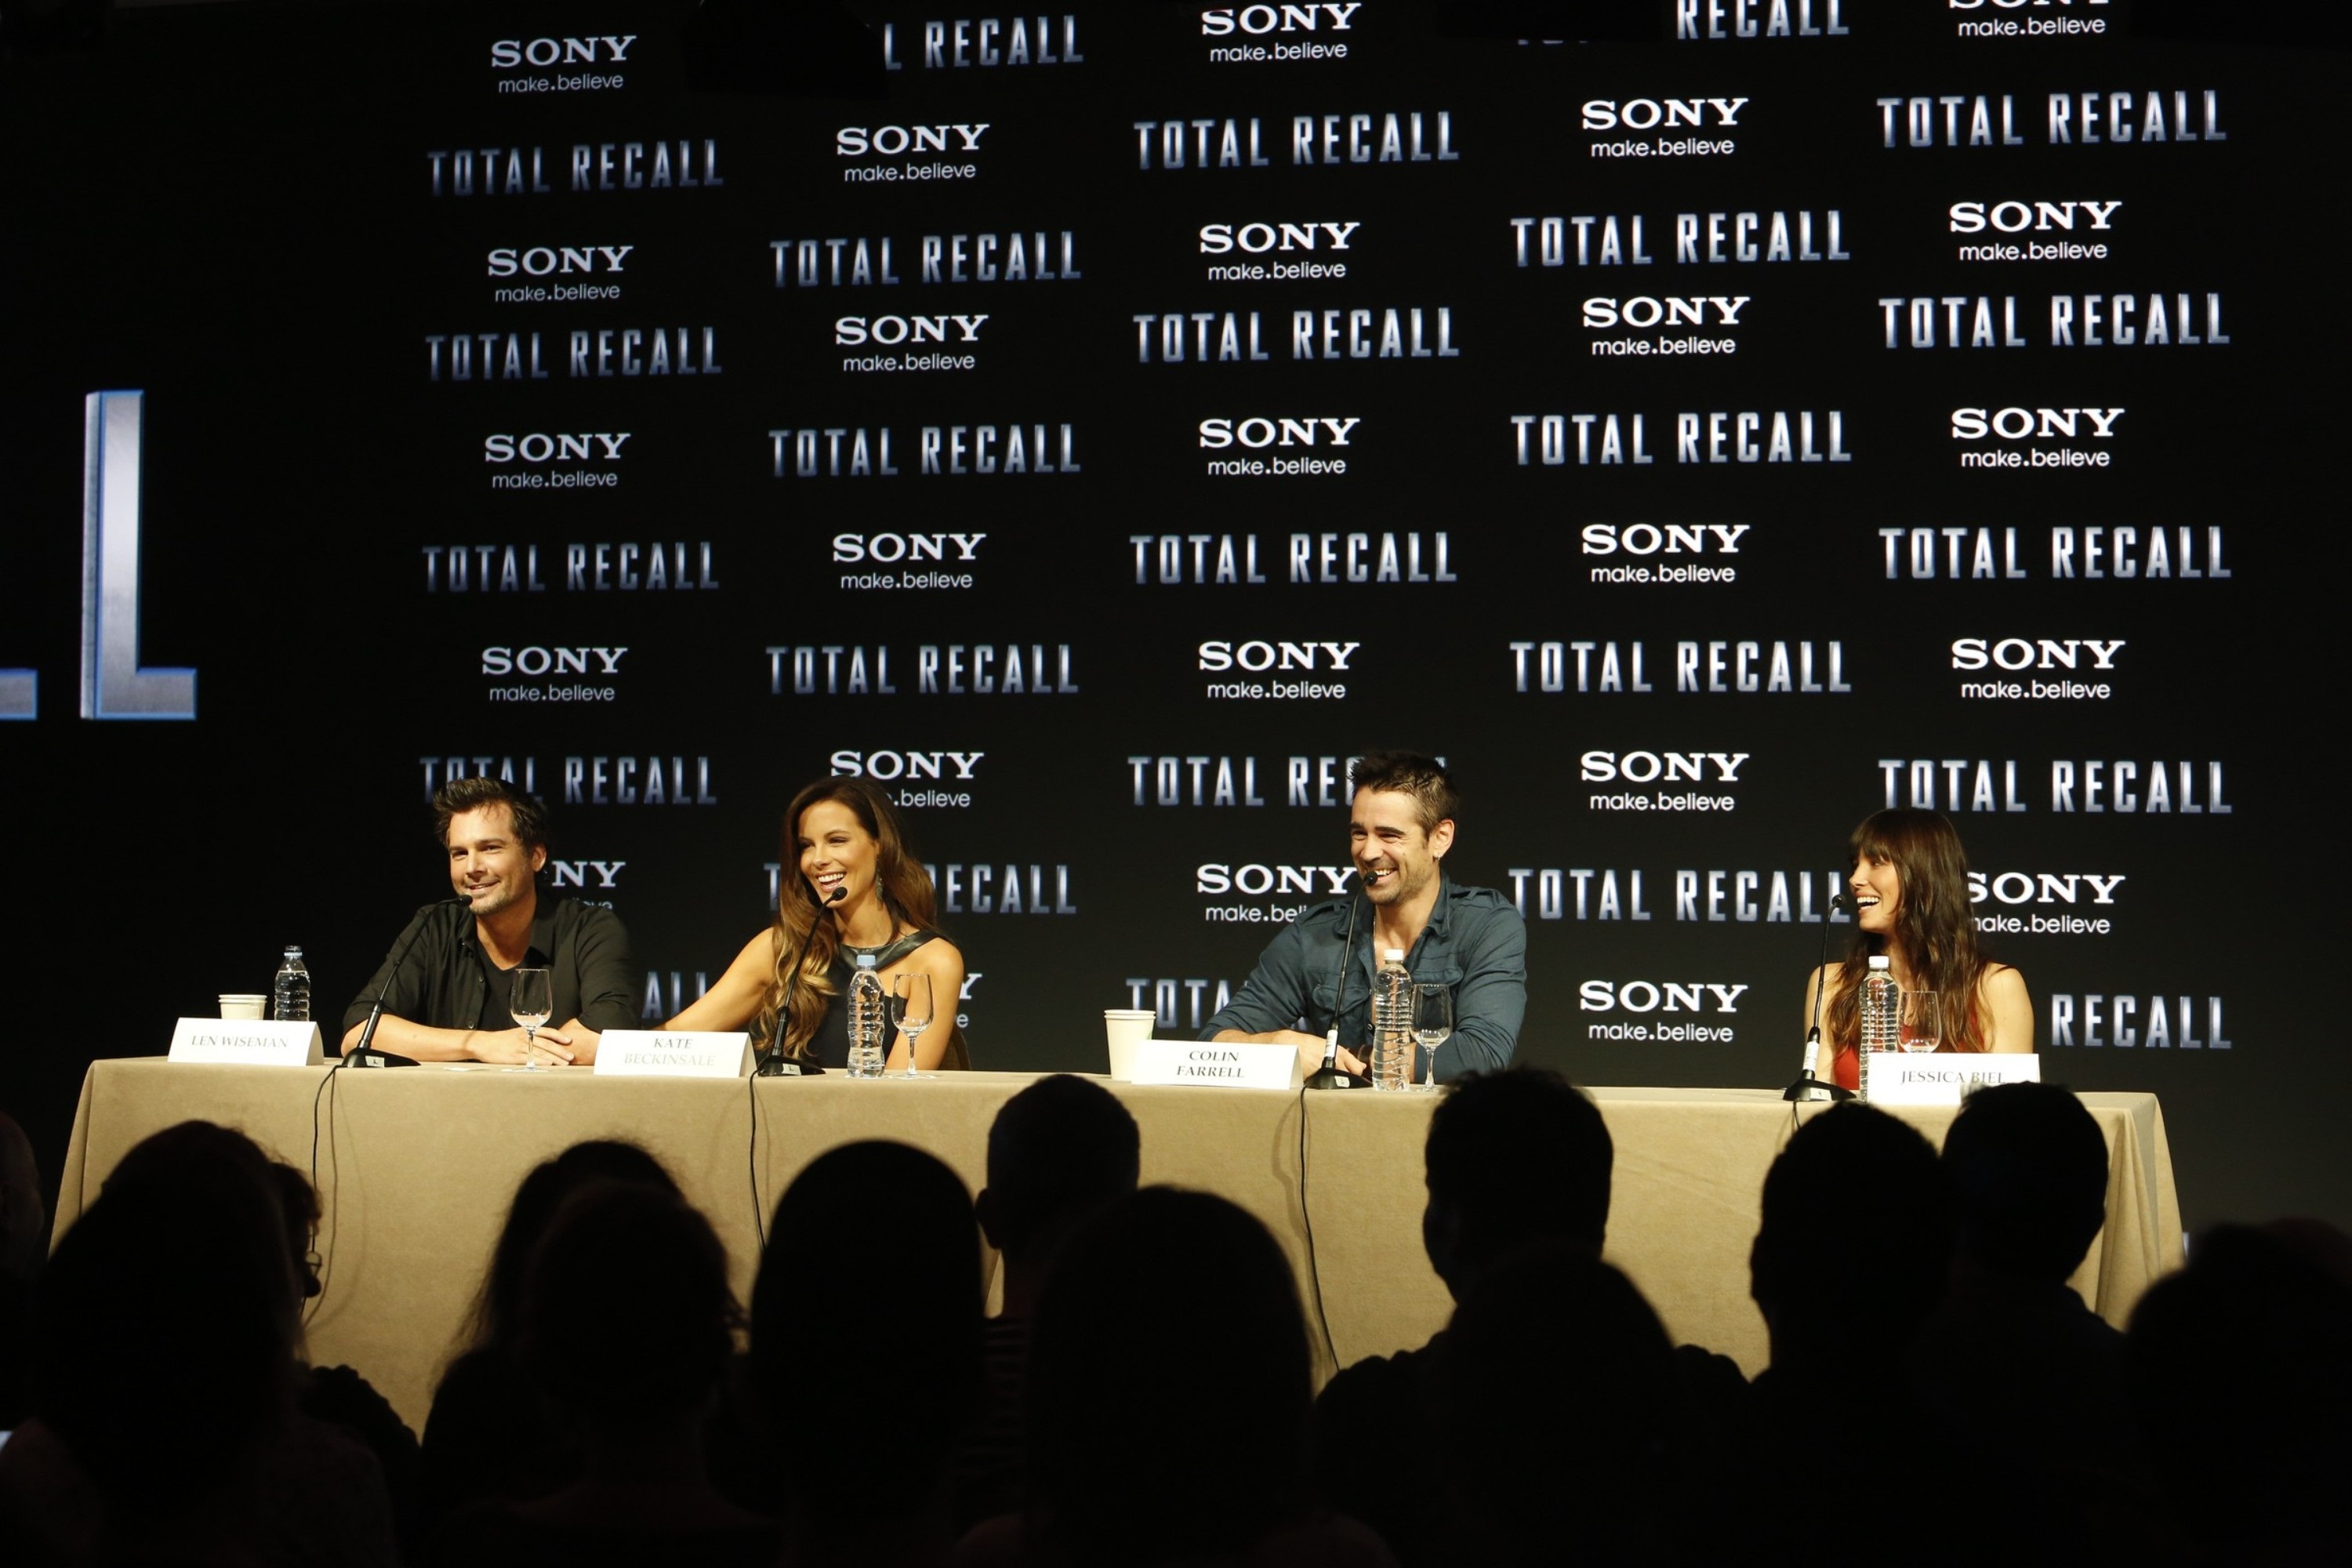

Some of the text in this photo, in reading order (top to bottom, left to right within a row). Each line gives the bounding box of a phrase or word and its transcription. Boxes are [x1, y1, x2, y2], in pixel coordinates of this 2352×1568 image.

[1201, 2, 1362, 35] SONY
[1677, 0, 1849, 39] RECALL
[1958, 16, 2106, 37] make.believe
[492, 35, 637, 67] SONY
[925, 16, 1084, 69] RECALL
[1210, 42, 1348, 62] make.believe
[499, 74, 623, 93] make.believe
[1581, 97, 1749, 130] SONY
[1877, 90, 2227, 149] TOTAL RECALL
[837, 124, 990, 155] SONY
[1134, 111, 1460, 170] TOTAL RECALL
[1592, 137, 1735, 157] make.believe
[429, 140, 723, 194] TOTAL RECALL
[844, 162, 976, 181] make.believe
[1949, 201, 2122, 233] SONY
[1200, 222, 1360, 254] SONY
[1511, 210, 1851, 268] TOTAL RECALL
[1959, 241, 2107, 261] make.believe
[488, 245, 633, 276] SONY
[771, 231, 1082, 287] TOTAL RECALL
[1208, 261, 1346, 281] make.believe
[495, 284, 620, 302] make.believe
[1582, 296, 1751, 328] SONY
[1878, 293, 2231, 350] TOTAL RECALL
[835, 314, 989, 345] SONY
[1134, 307, 1461, 364] TOTAL RECALL
[426, 328, 722, 380] TOTAL RECALL
[1592, 336, 1736, 355] make.believe
[844, 353, 975, 372] make.believe
[1199, 417, 1360, 448] SONY
[1511, 411, 1853, 466] TOTAL RECALL
[1951, 407, 2125, 439] SONY
[485, 433, 631, 462] SONY
[769, 424, 1082, 477] TOTAL RECALL
[1961, 448, 2111, 467] make.believe
[492, 470, 618, 488] make.believe
[1208, 456, 1346, 475] make.believe
[833, 533, 986, 562] SONY
[1581, 523, 1751, 555] SONY
[1878, 526, 2233, 580] TOTAL RECALL
[423, 543, 719, 591] TOTAL RECALL
[1131, 532, 1458, 585] TOTAL RECALL
[1592, 563, 1736, 583] make.believe
[840, 571, 973, 589] make.believe
[482, 646, 628, 675] SONY
[1199, 641, 1360, 671] SONY
[1510, 641, 1853, 694] TOTAL RECALL
[1951, 638, 2126, 670] SONY
[767, 645, 1080, 695] TOTAL RECALL
[490, 684, 615, 701] make.believe
[1207, 680, 1346, 699] make.believe
[1961, 679, 2111, 699] make.believe
[564, 757, 717, 804] RECALL
[830, 750, 984, 780] SONY
[1581, 750, 1750, 782] SONY
[1128, 756, 1265, 806] TOTAL
[1878, 760, 2232, 814] TOTAL RECALL
[887, 789, 971, 808] .believe
[1590, 792, 1735, 811] make.believe
[552, 860, 626, 887] NY
[1197, 864, 1357, 895] SONY
[1967, 872, 2125, 905] SONY
[1508, 869, 1851, 923] TOTAL RECALL
[1126, 979, 1248, 1029] TOTA
[1579, 980, 1748, 1013] SONY
[1588, 1022, 1733, 1043] make.believe
[2052, 994, 2232, 1049] RECALL
[191, 1035, 289, 1048] LEN WISEMAN
[654, 1038, 693, 1049] KATE
[1189, 1050, 1240, 1062] COLIN
[624, 1053, 716, 1066] BECKINSALE
[1177, 1065, 1245, 1078] FARRELL
[1900, 1070, 2007, 1084] JESSICA BIEL
